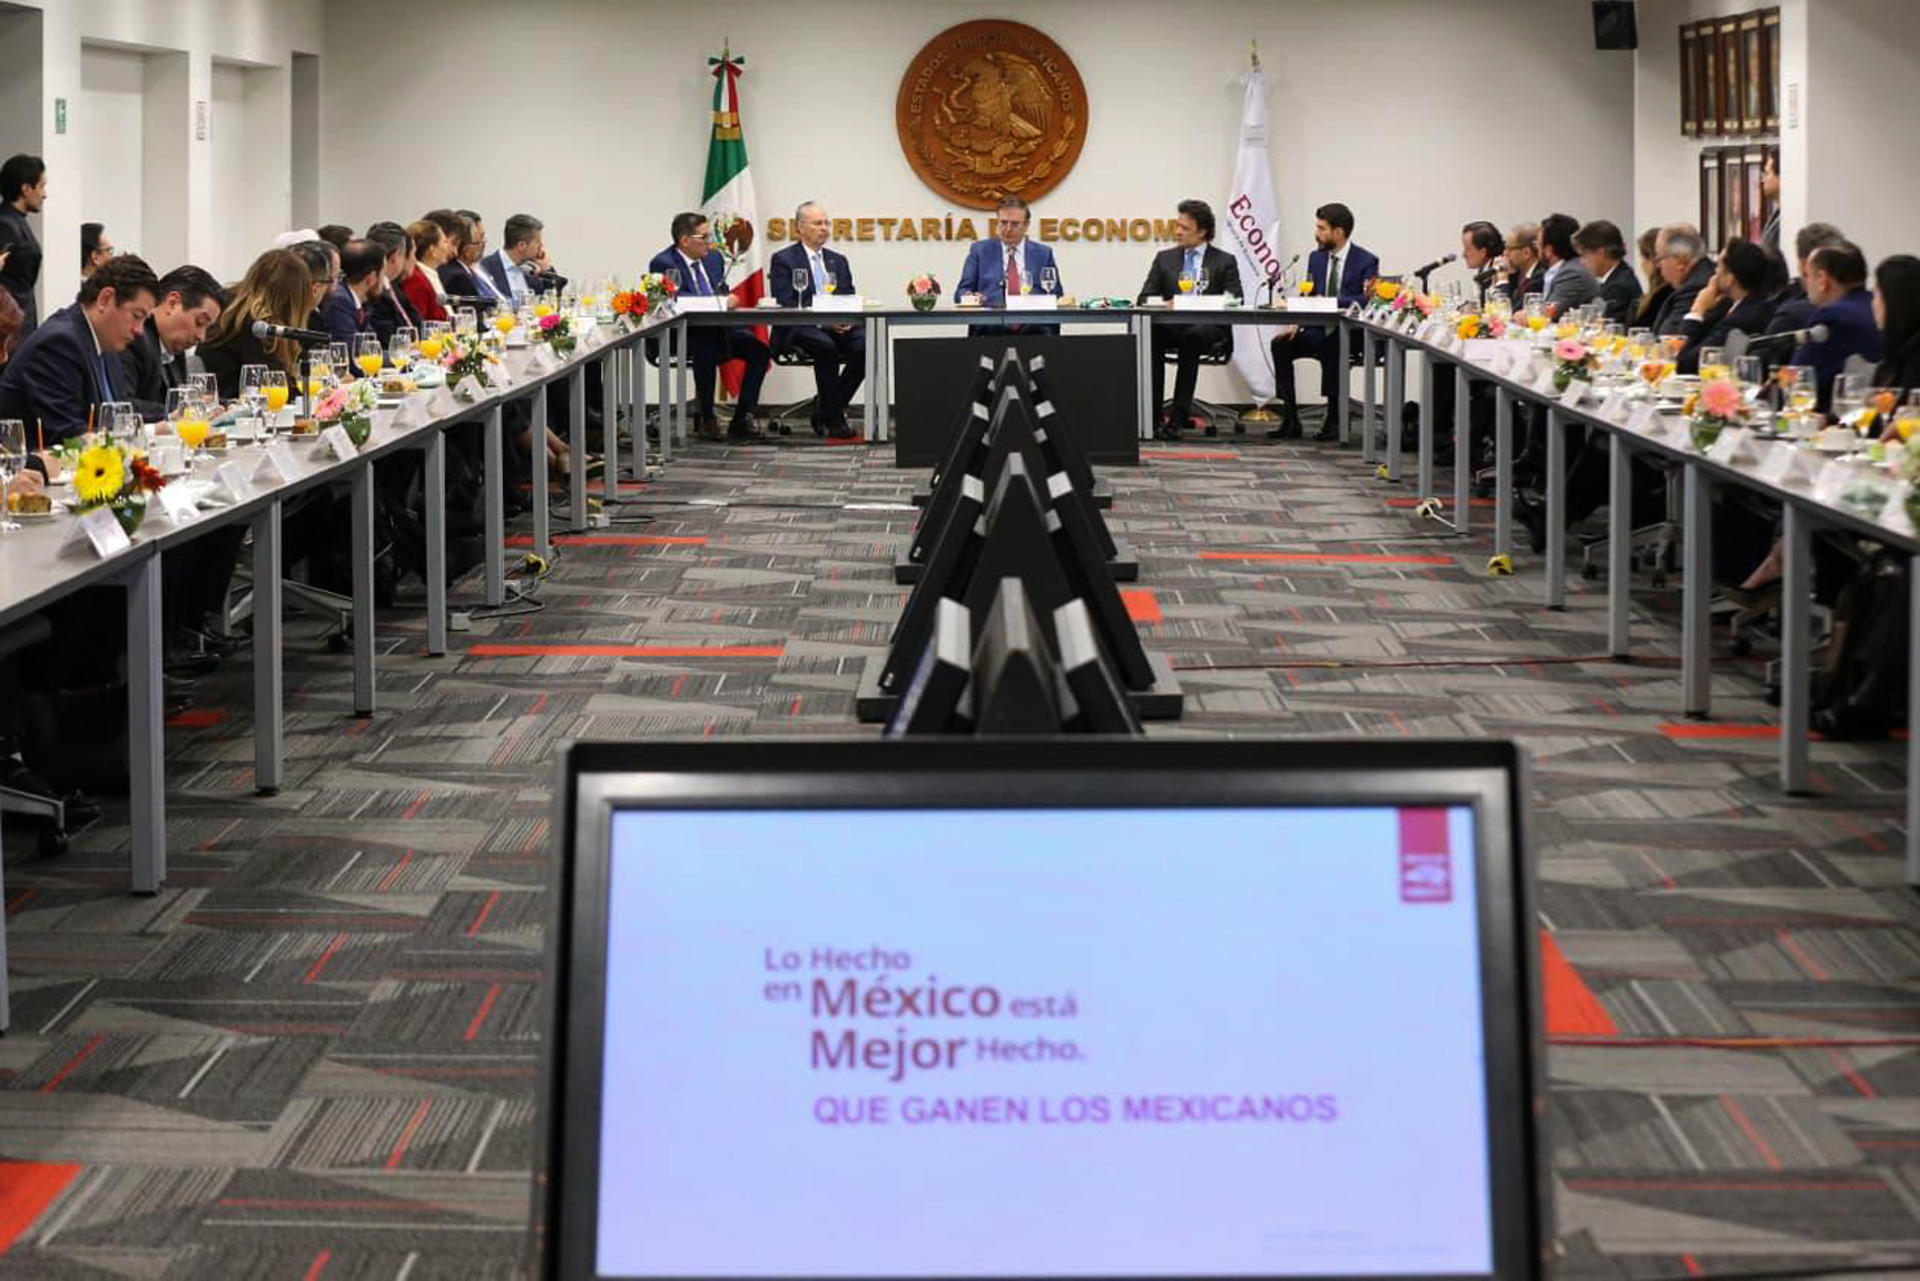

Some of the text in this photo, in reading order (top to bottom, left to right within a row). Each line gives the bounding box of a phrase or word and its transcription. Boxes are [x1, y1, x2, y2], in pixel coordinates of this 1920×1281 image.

[911, 51, 949, 114] ESTADOS
[766, 212, 978, 242] SERETARÍA
[1039, 217, 1178, 242] ECONOM
[765, 945, 911, 971] Lo Hecho
[764, 973, 1077, 1019] en México está
[810, 1026, 968, 1083] Mejor
[814, 1095, 1338, 1124] QUE GANEN LOS MEXICANOS
